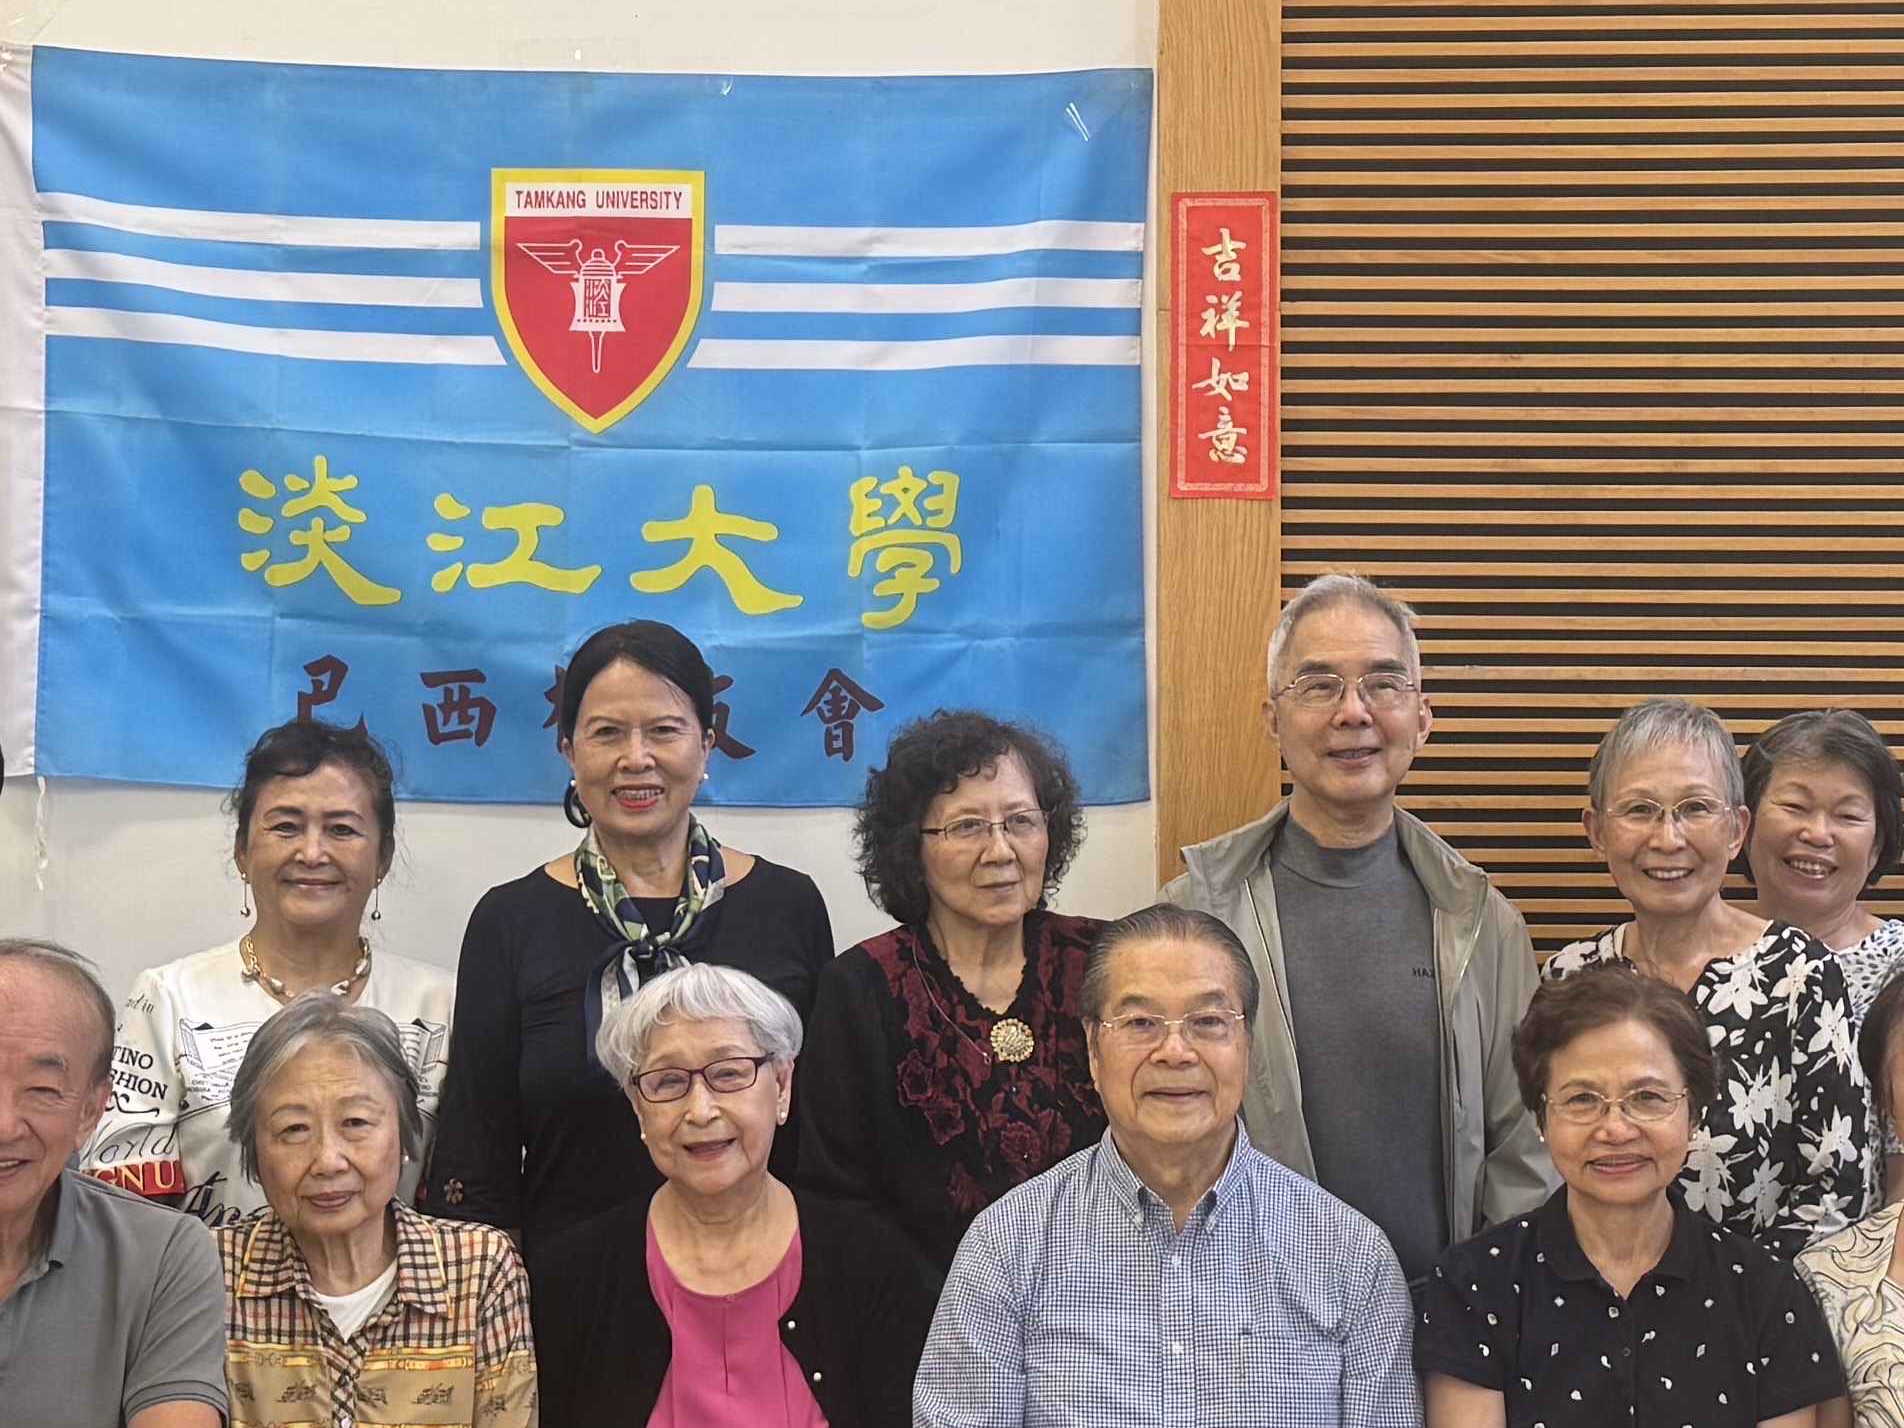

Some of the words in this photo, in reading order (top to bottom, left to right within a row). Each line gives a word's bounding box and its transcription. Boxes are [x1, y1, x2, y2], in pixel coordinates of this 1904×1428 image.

[515, 189, 587, 209] TAMKANG
[595, 189, 684, 211] UNIVERSITY
[1191, 227, 1250, 465] 吉祥如意
[238, 454, 963, 630] 淡江大學
[296, 654, 885, 762] 巴西會
